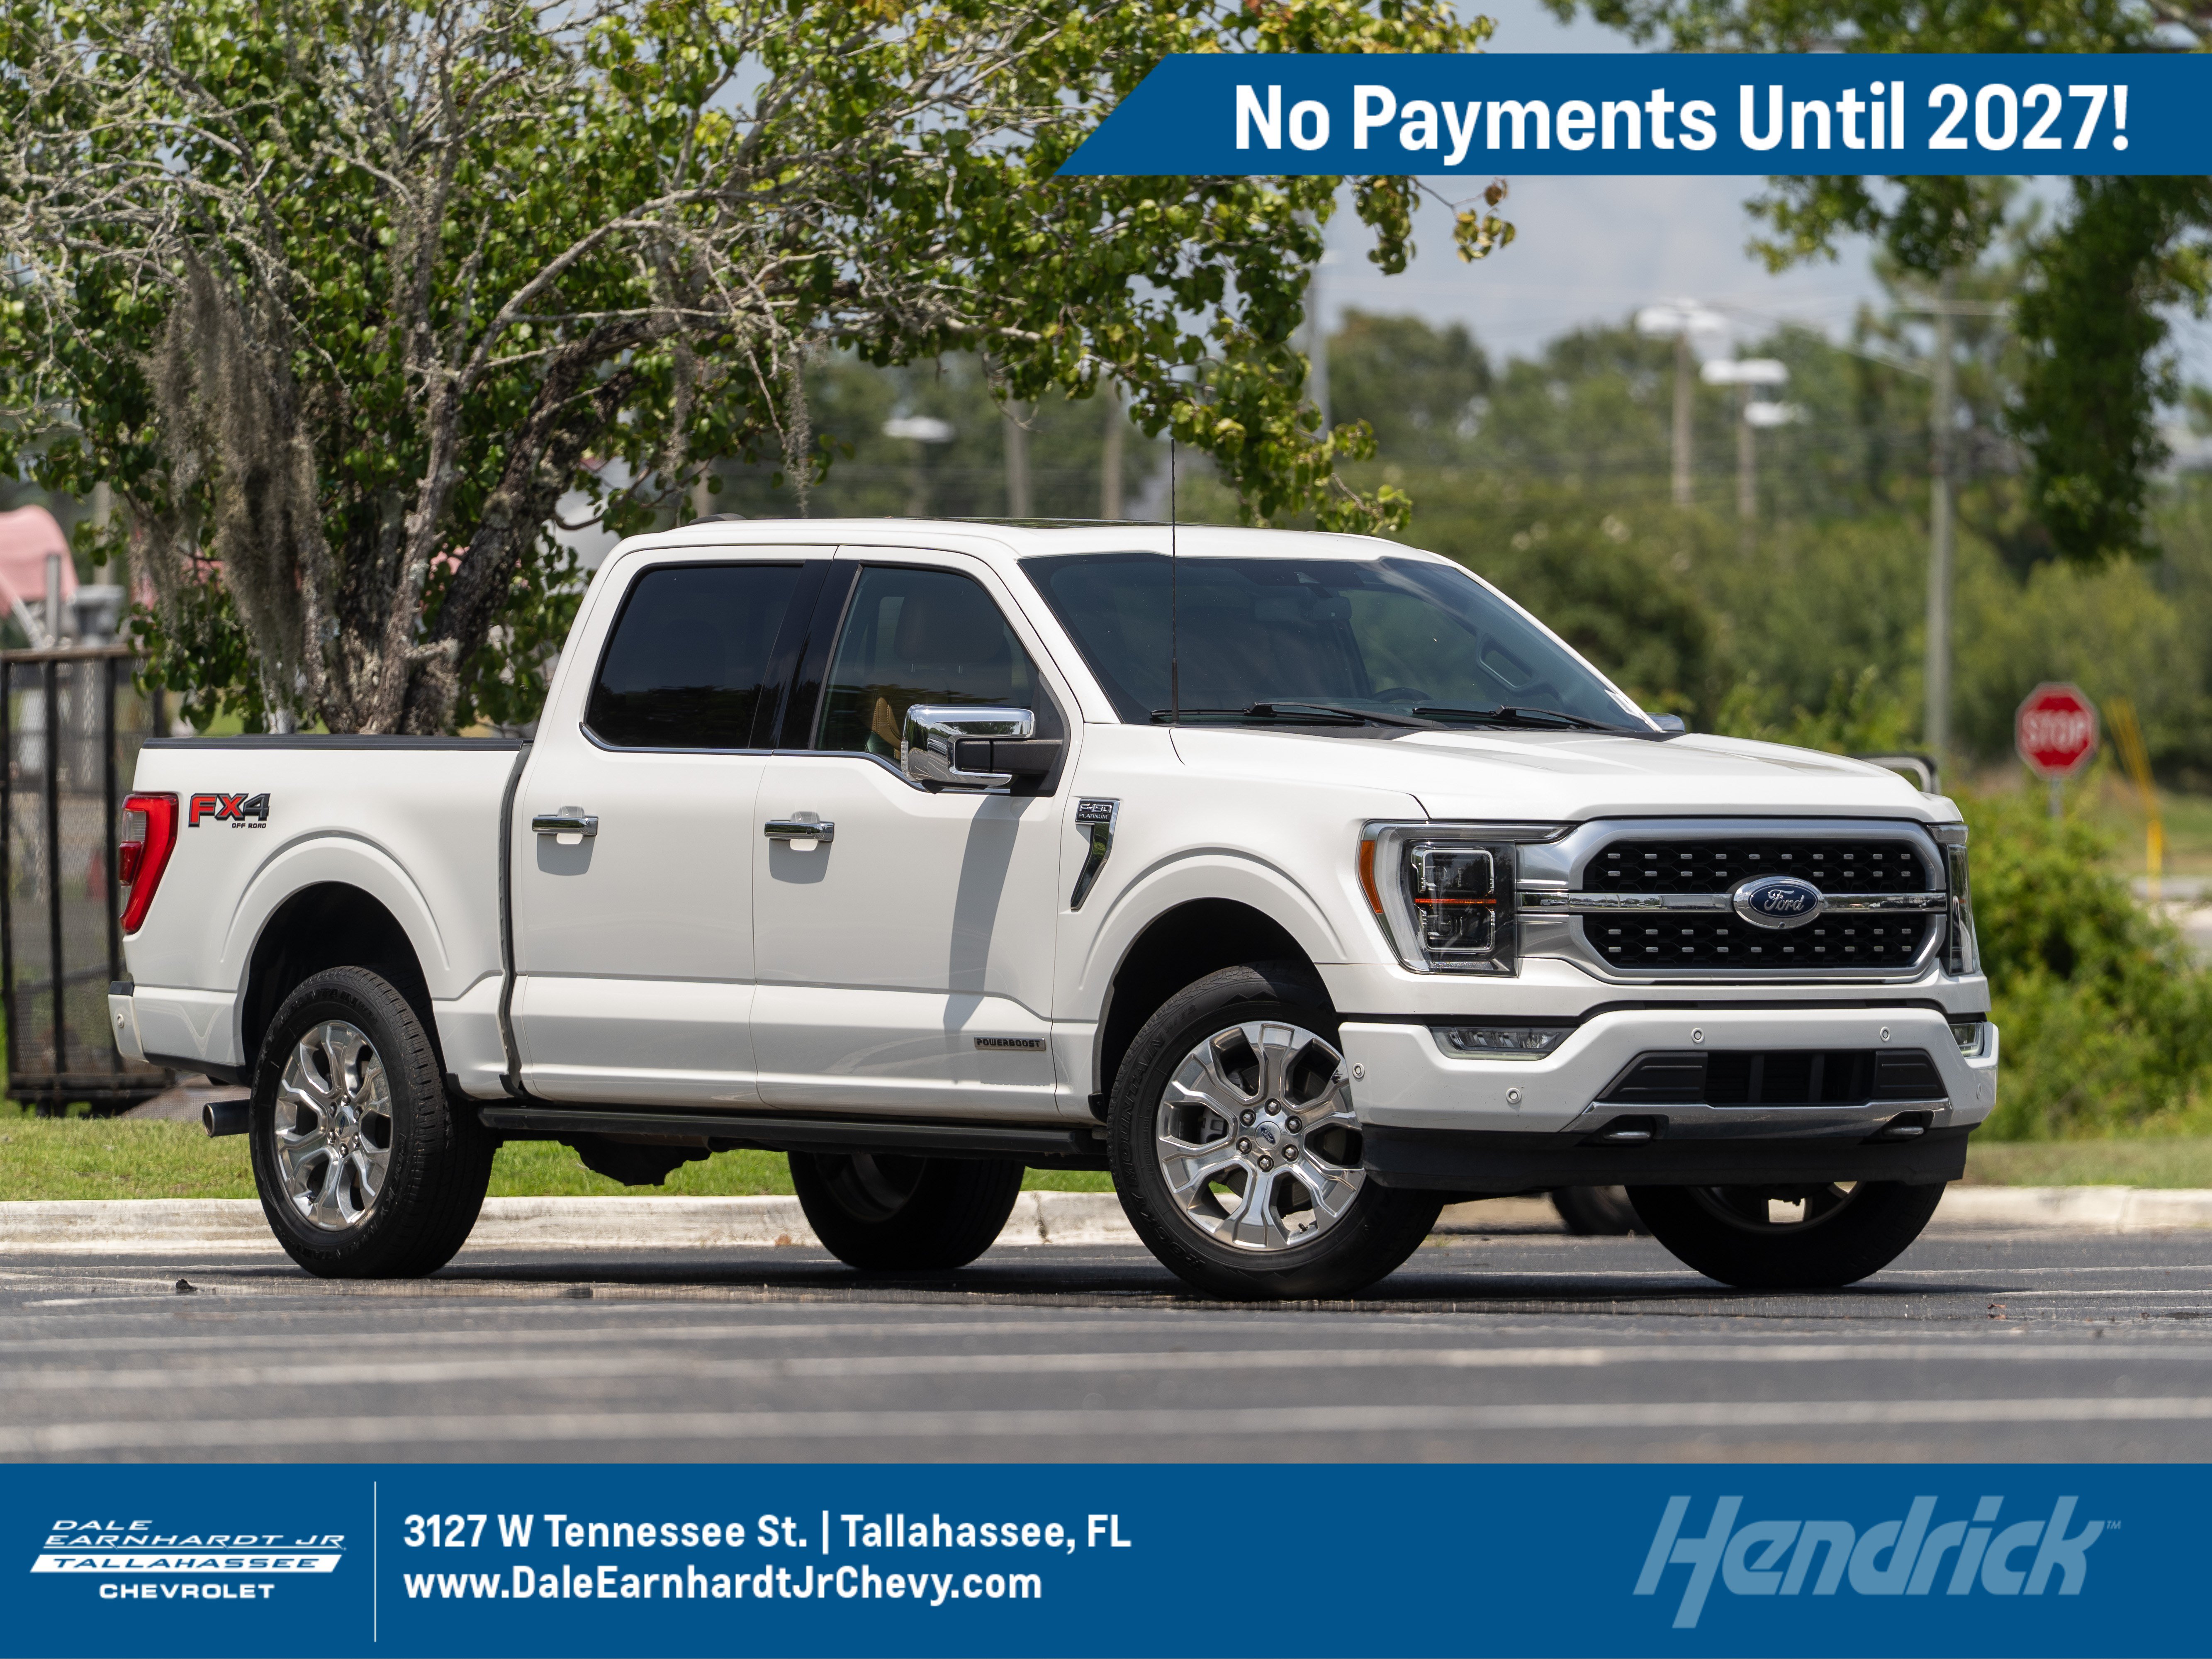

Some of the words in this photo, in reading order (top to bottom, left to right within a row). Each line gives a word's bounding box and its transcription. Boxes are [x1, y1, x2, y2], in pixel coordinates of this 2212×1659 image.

[2022, 710, 2090, 752] STOP
[188, 793, 270, 827] FX4
[1764, 889, 1805, 911] Ford
[976, 1038, 1040, 1048] POWERBOOST
[1119, 1031, 1165, 1187] MOUNTAIN
[1262, 1130, 1274, 1142] Ford
[1131, 1192, 1207, 1271] ROCKY
